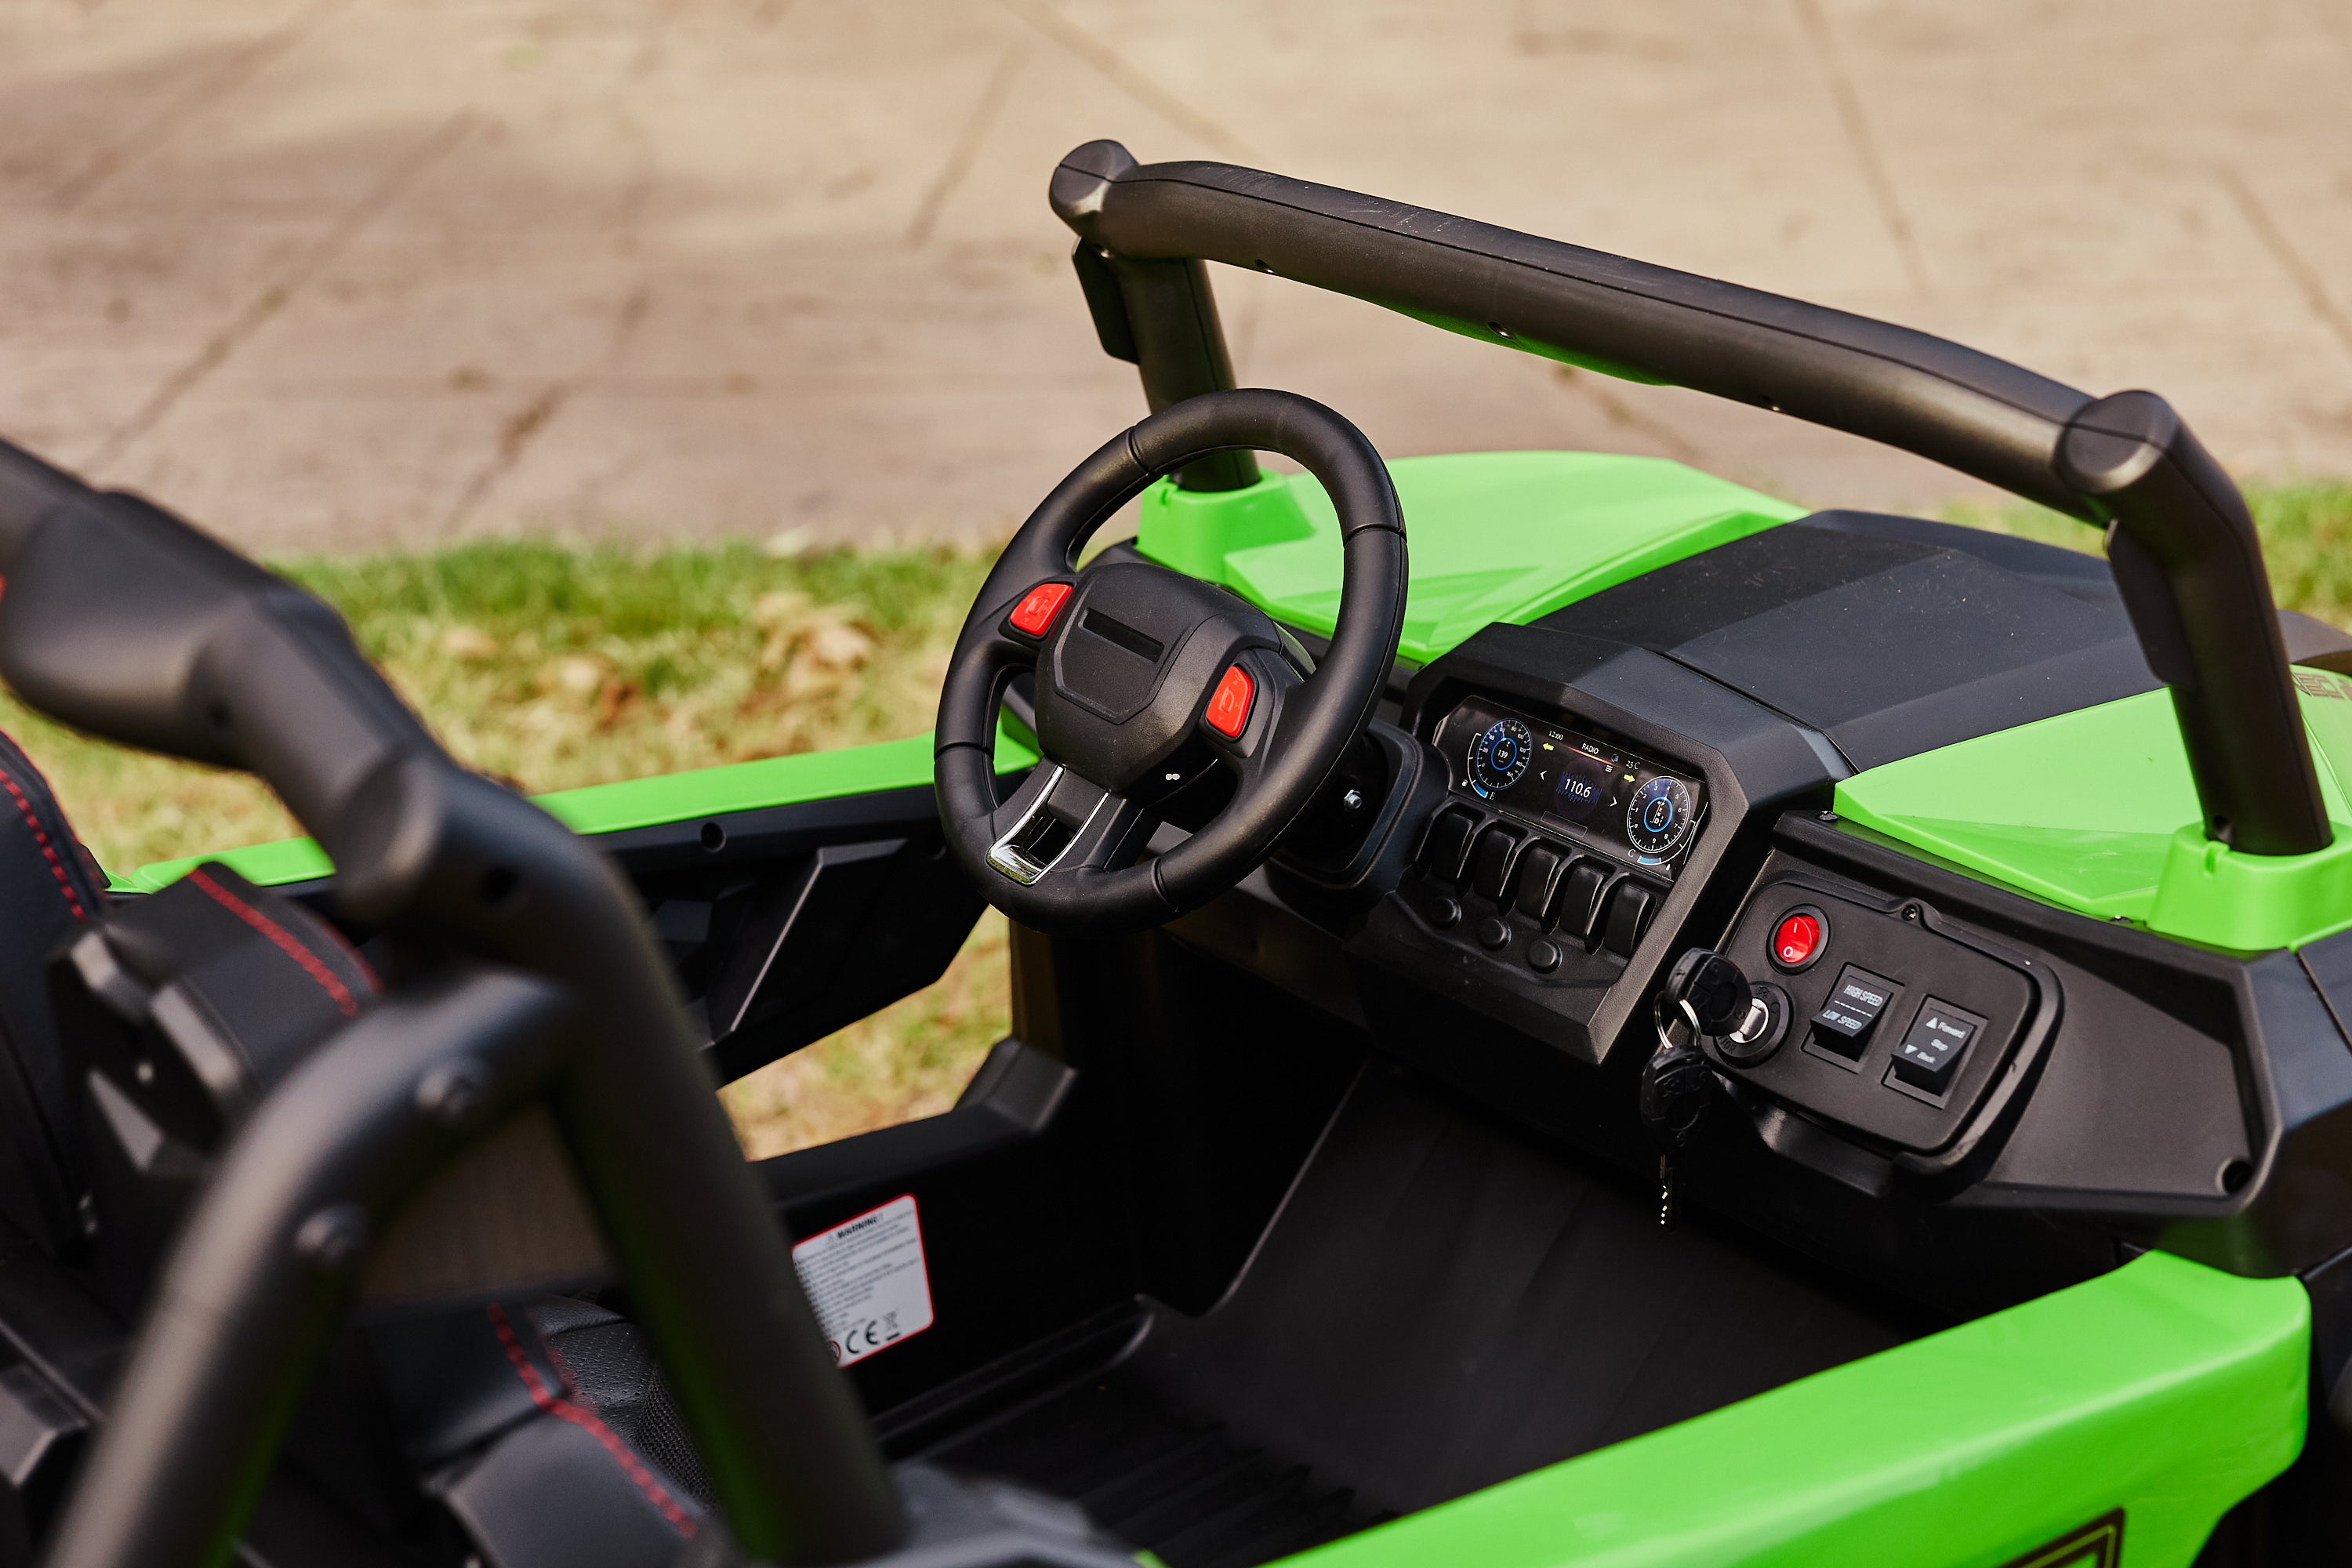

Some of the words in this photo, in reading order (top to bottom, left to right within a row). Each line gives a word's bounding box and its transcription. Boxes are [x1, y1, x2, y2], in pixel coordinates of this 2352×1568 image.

[1549, 730, 1563, 741] 12:00
[1497, 749, 1508, 759] 139
[1581, 742, 1599, 755] RADIO
[1565, 779, 1592, 798] 110.6
[1490, 791, 1496, 800] E
[1628, 848, 1636, 858] C
[1843, 984, 1864, 1000] HIGH
[1859, 990, 1883, 1007] SPEED
[1822, 1009, 1842, 1021] LOW
[1837, 1015, 1863, 1030] SPEED
